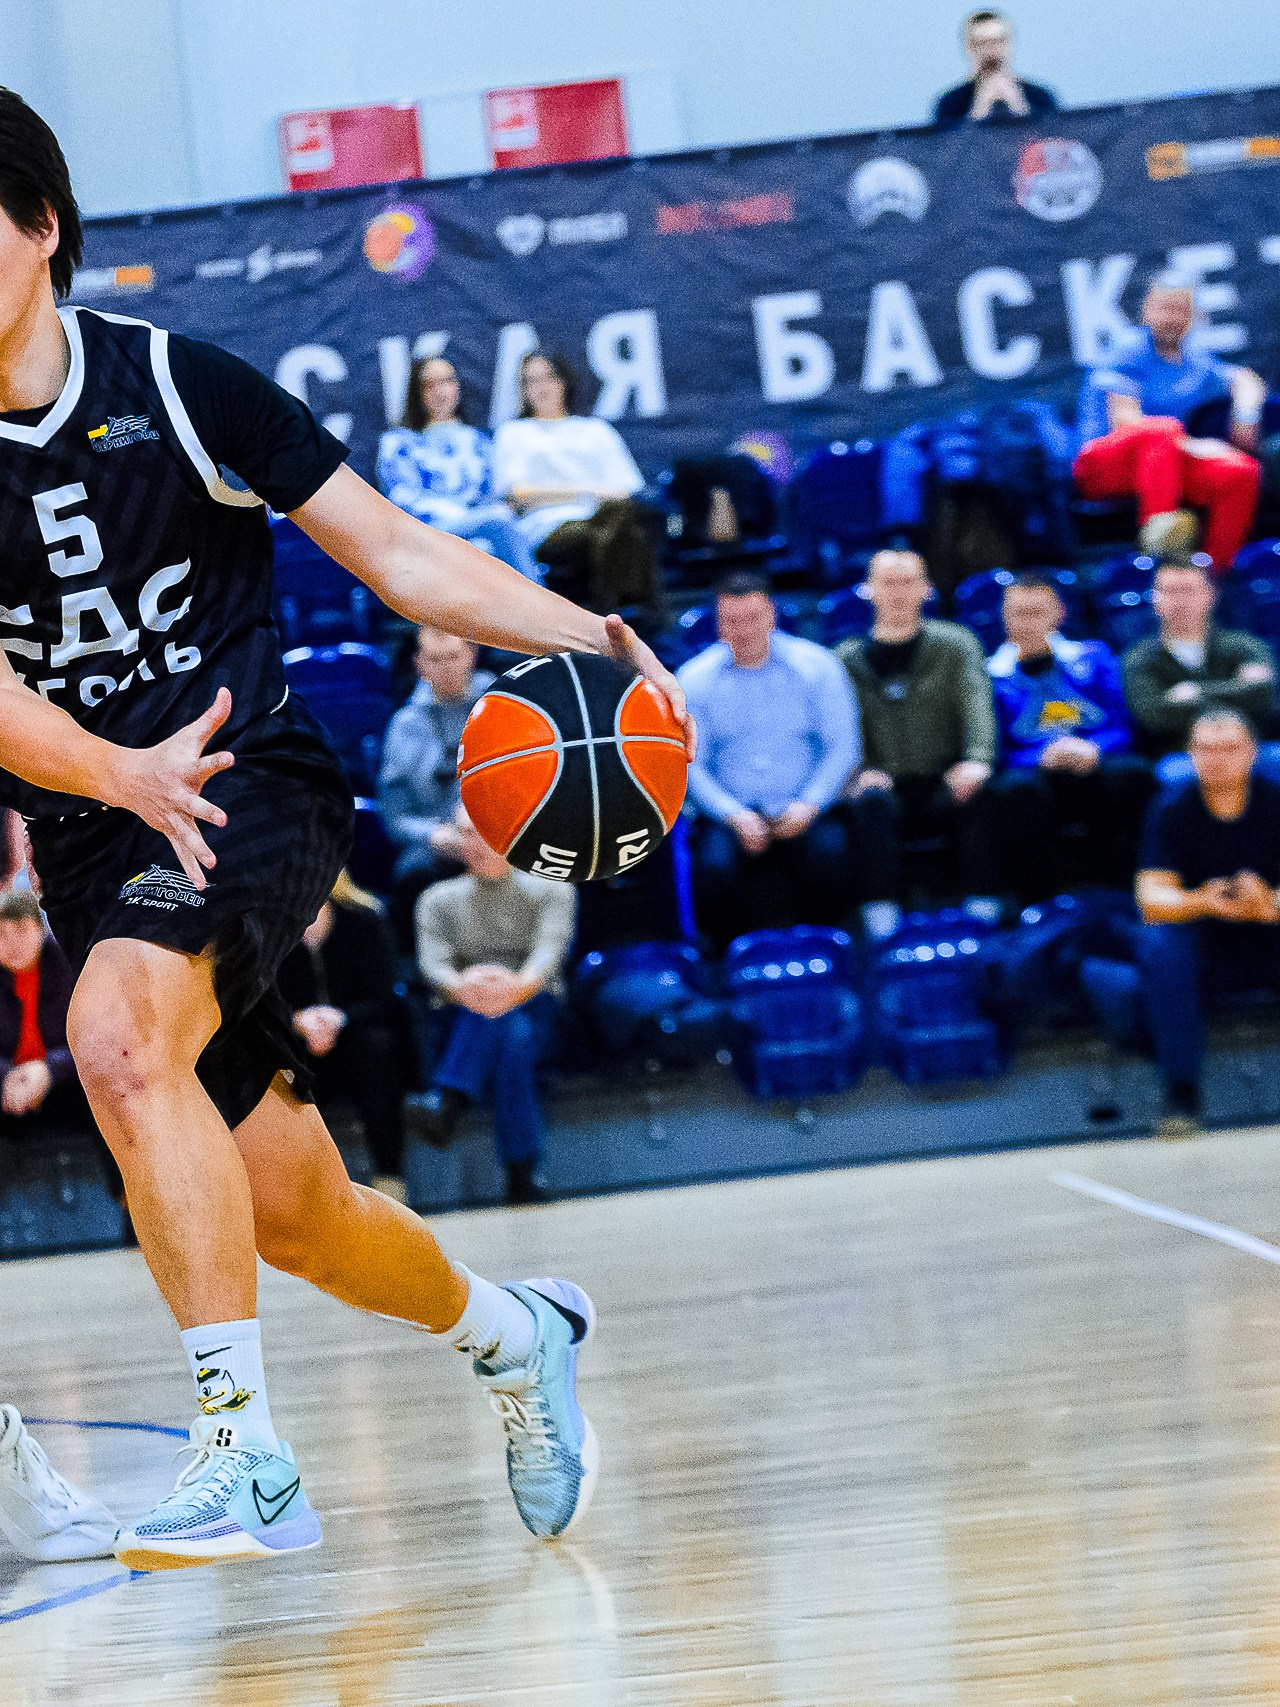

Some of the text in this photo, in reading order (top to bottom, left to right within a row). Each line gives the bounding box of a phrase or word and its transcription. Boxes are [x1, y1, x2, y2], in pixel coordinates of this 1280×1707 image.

[752, 236, 1280, 402] БАСКЕ
[32, 482, 104, 578] 5
[16, 642, 202, 707] ГОЛЬ
[141, 898, 179, 911] SPORT
